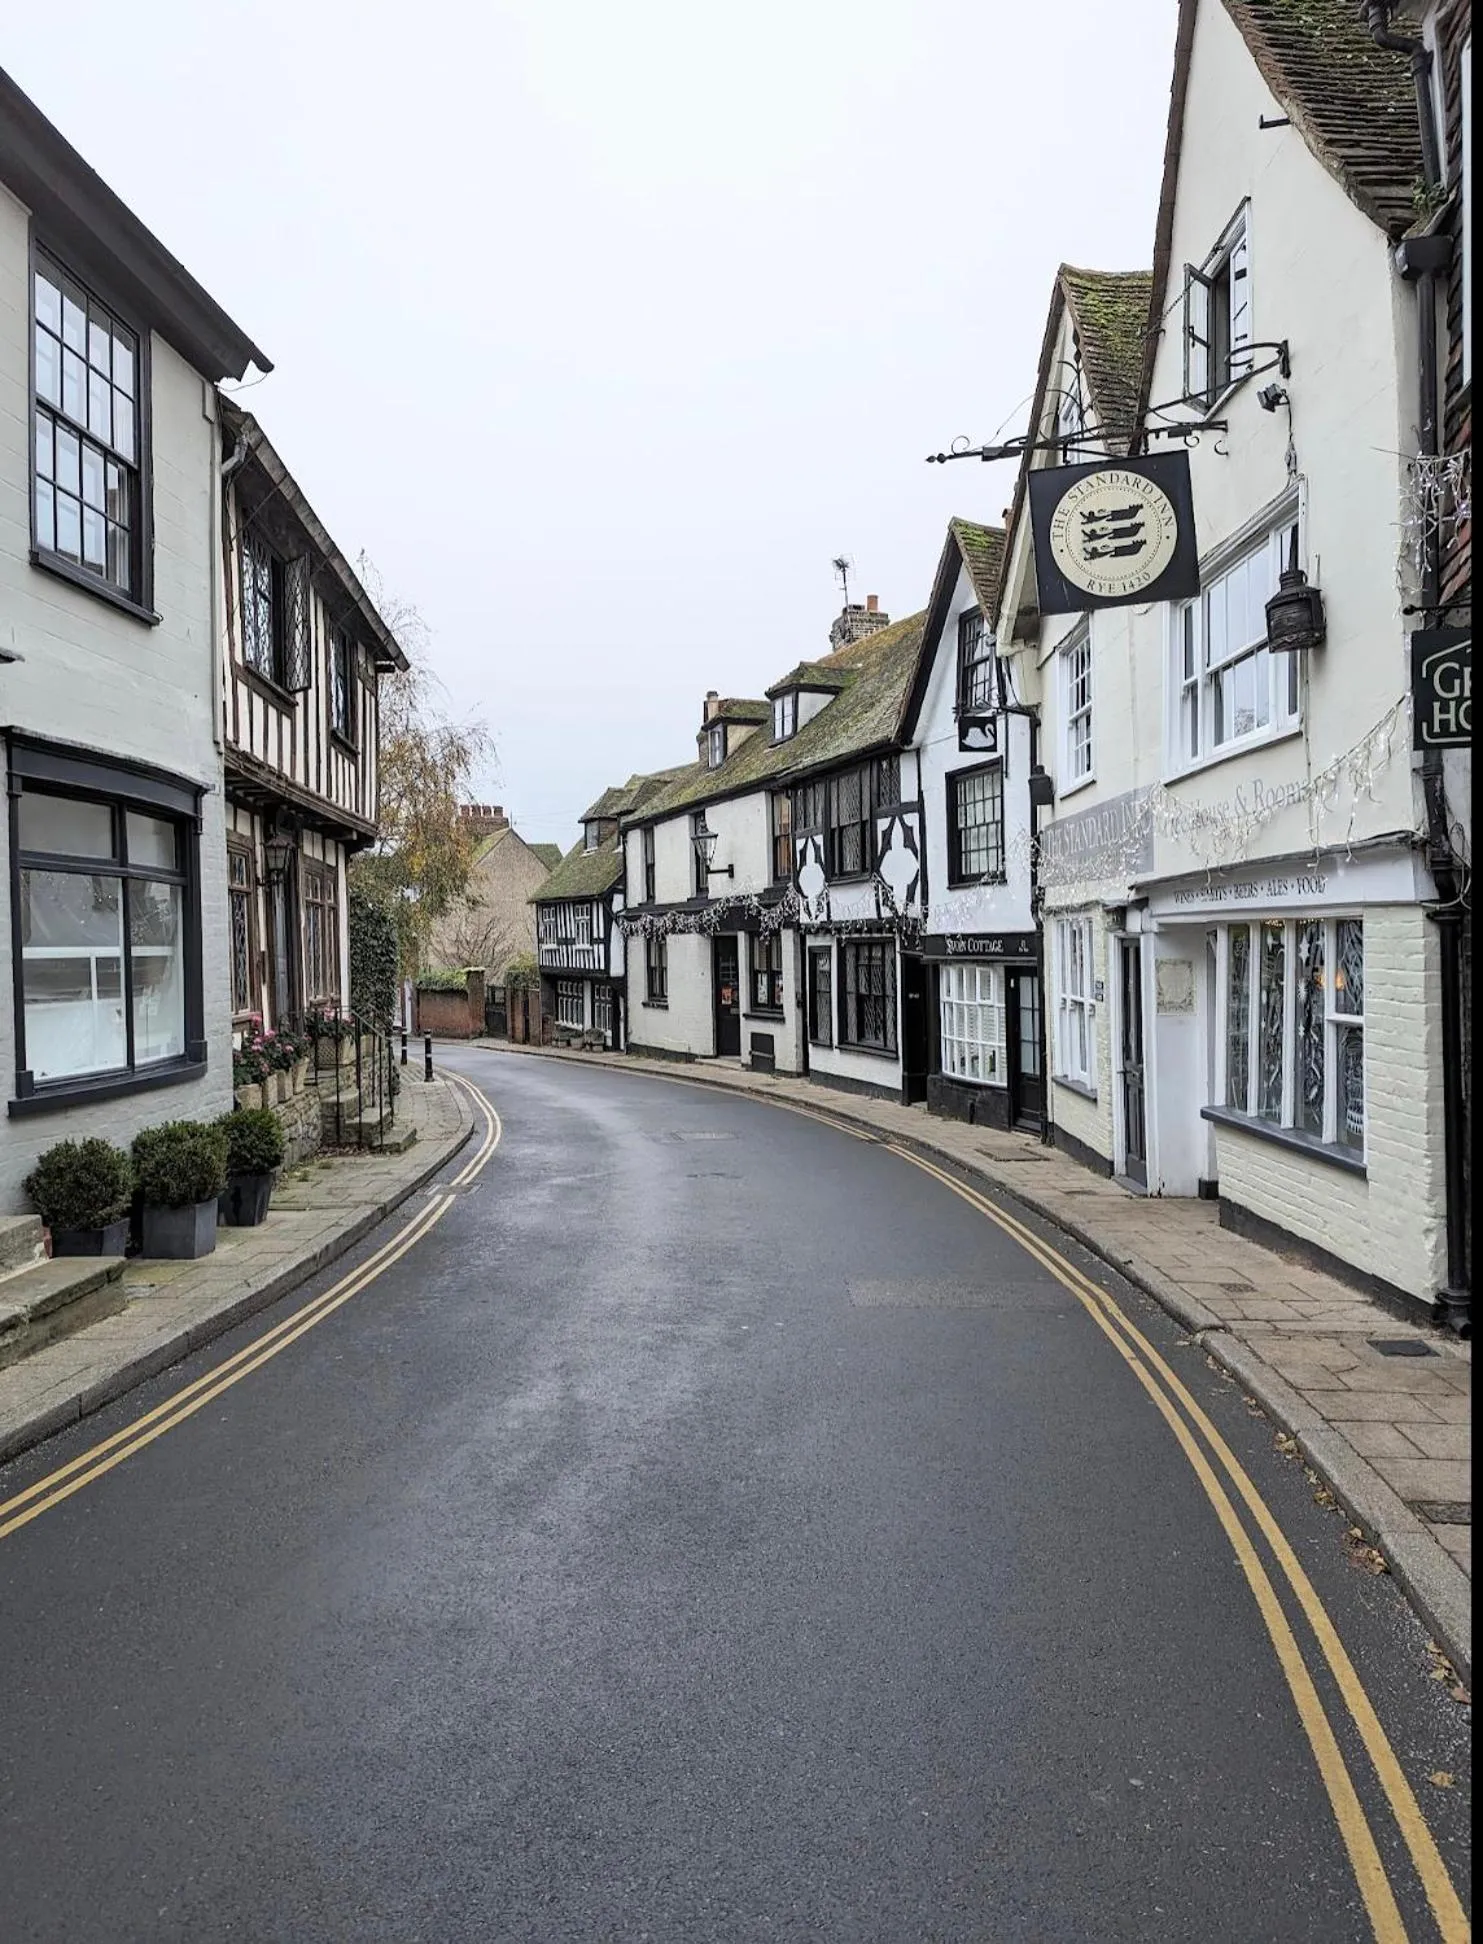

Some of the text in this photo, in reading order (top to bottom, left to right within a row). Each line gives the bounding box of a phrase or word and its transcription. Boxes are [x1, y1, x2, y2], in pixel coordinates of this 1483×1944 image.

[1053, 473, 1175, 540] THE STANDARD INN
[1087, 571, 1152, 593] RYE 1420
[1063, 806, 1119, 858] STANDARD
[1234, 881, 1258, 899] BEERS
[1266, 877, 1288, 897] ALES
[1296, 874, 1327, 895] FOOD
[967, 937, 1004, 953] COTTAGE
